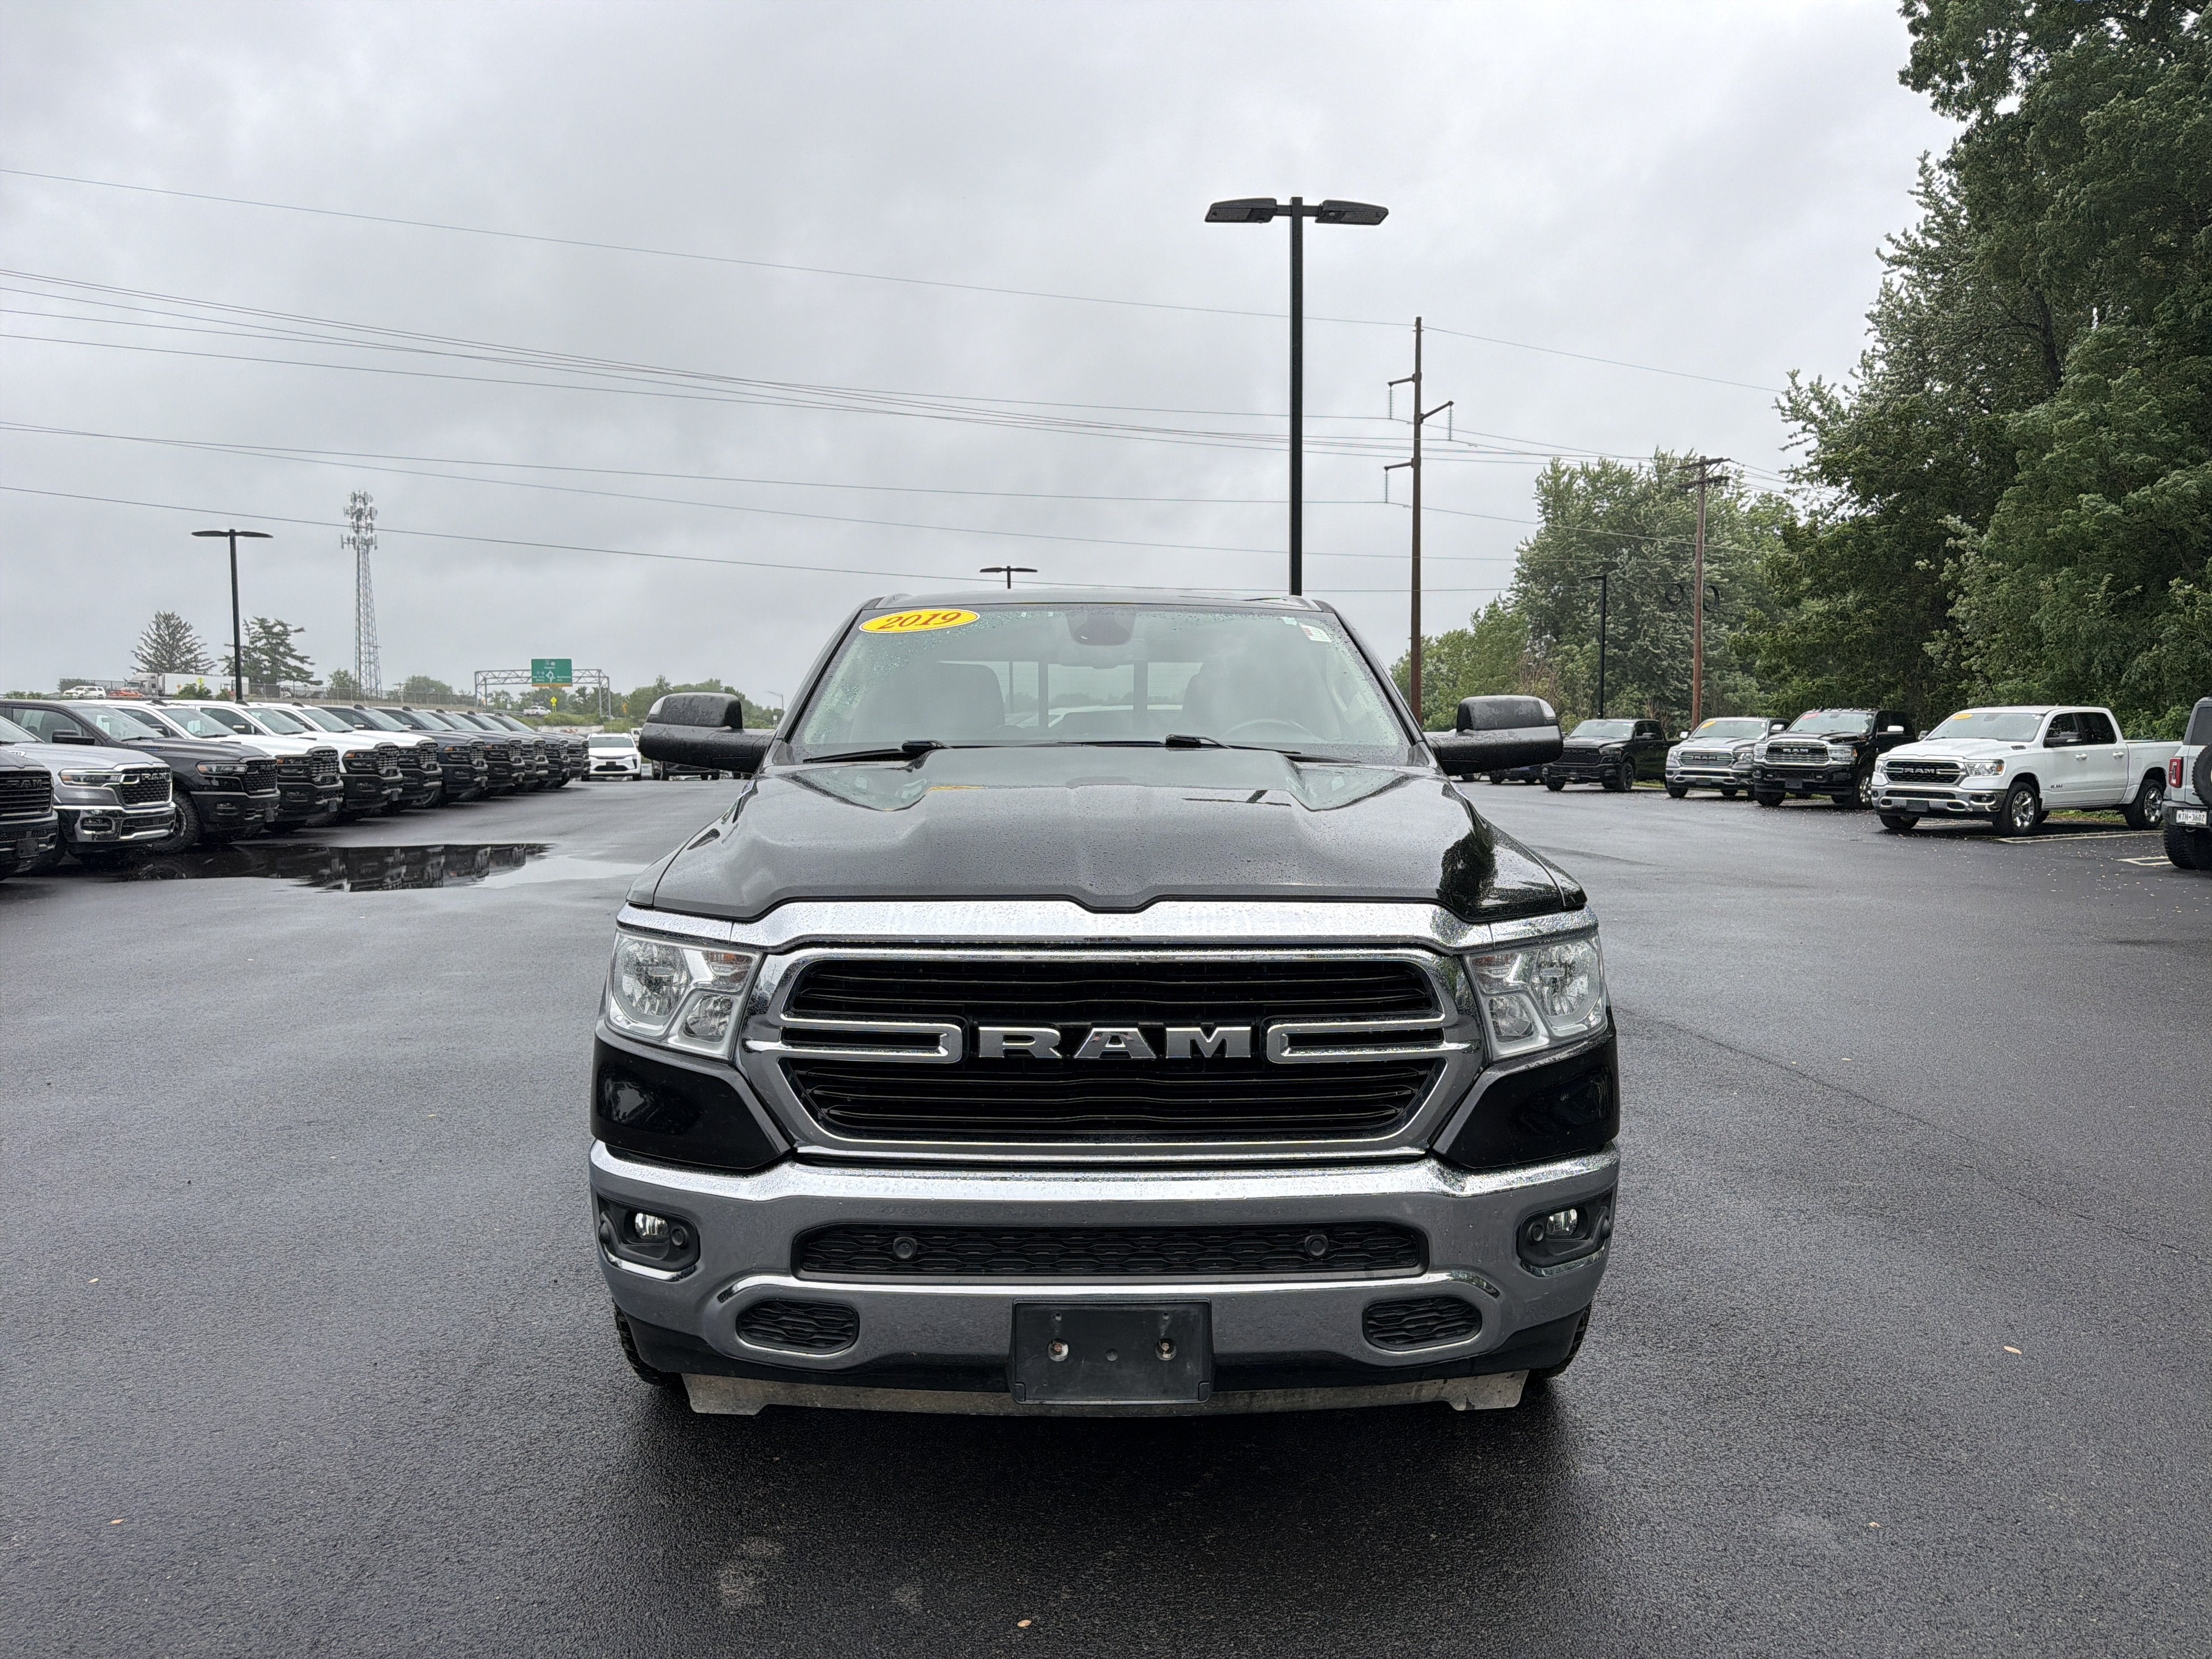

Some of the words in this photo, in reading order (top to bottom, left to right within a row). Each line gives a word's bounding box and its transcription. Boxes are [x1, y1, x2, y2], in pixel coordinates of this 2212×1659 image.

[876, 612, 962, 630] 2019
[7, 779, 42, 788] RAM
[978, 1026, 1252, 1059] RAM
